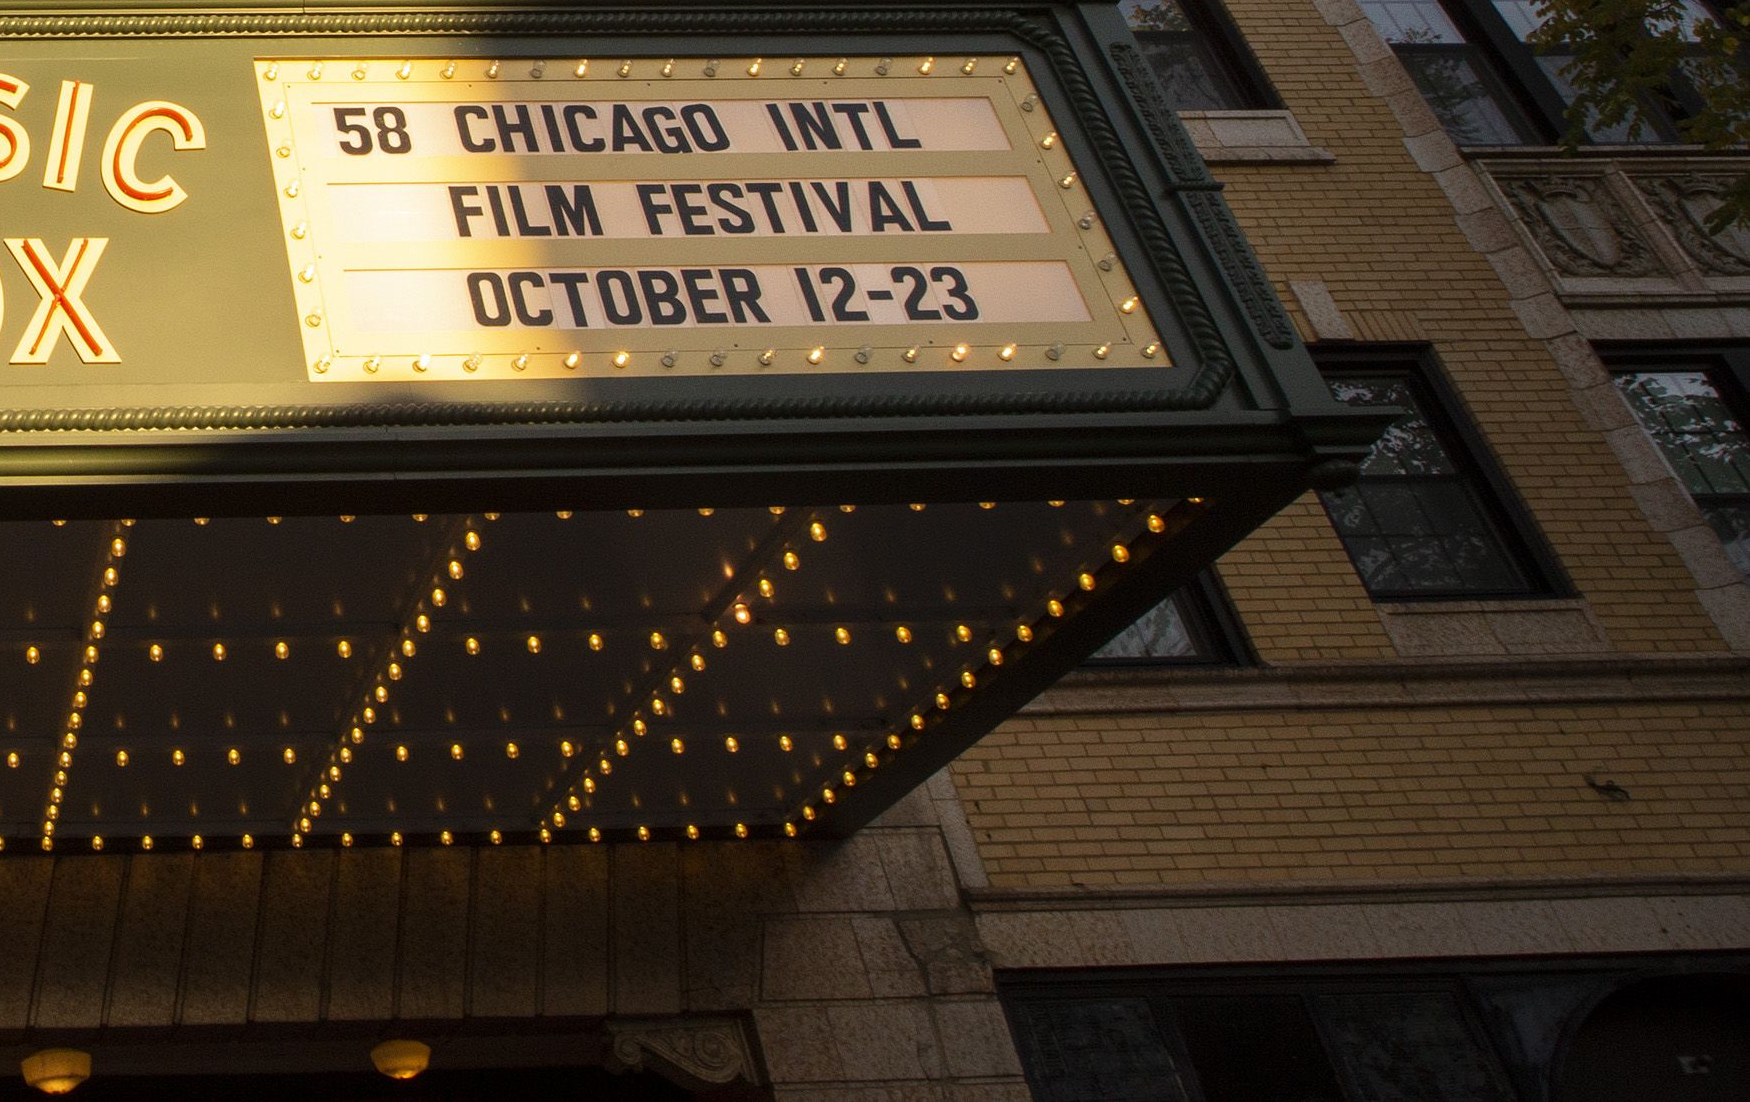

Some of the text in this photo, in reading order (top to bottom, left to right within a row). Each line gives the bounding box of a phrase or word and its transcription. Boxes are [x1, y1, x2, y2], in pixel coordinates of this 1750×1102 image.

[333, 100, 923, 156] 58 CHICAGO INTL
[447, 180, 953, 238] FILM FESTIVAL
[465, 265, 980, 328] OCTOBER 12-23
